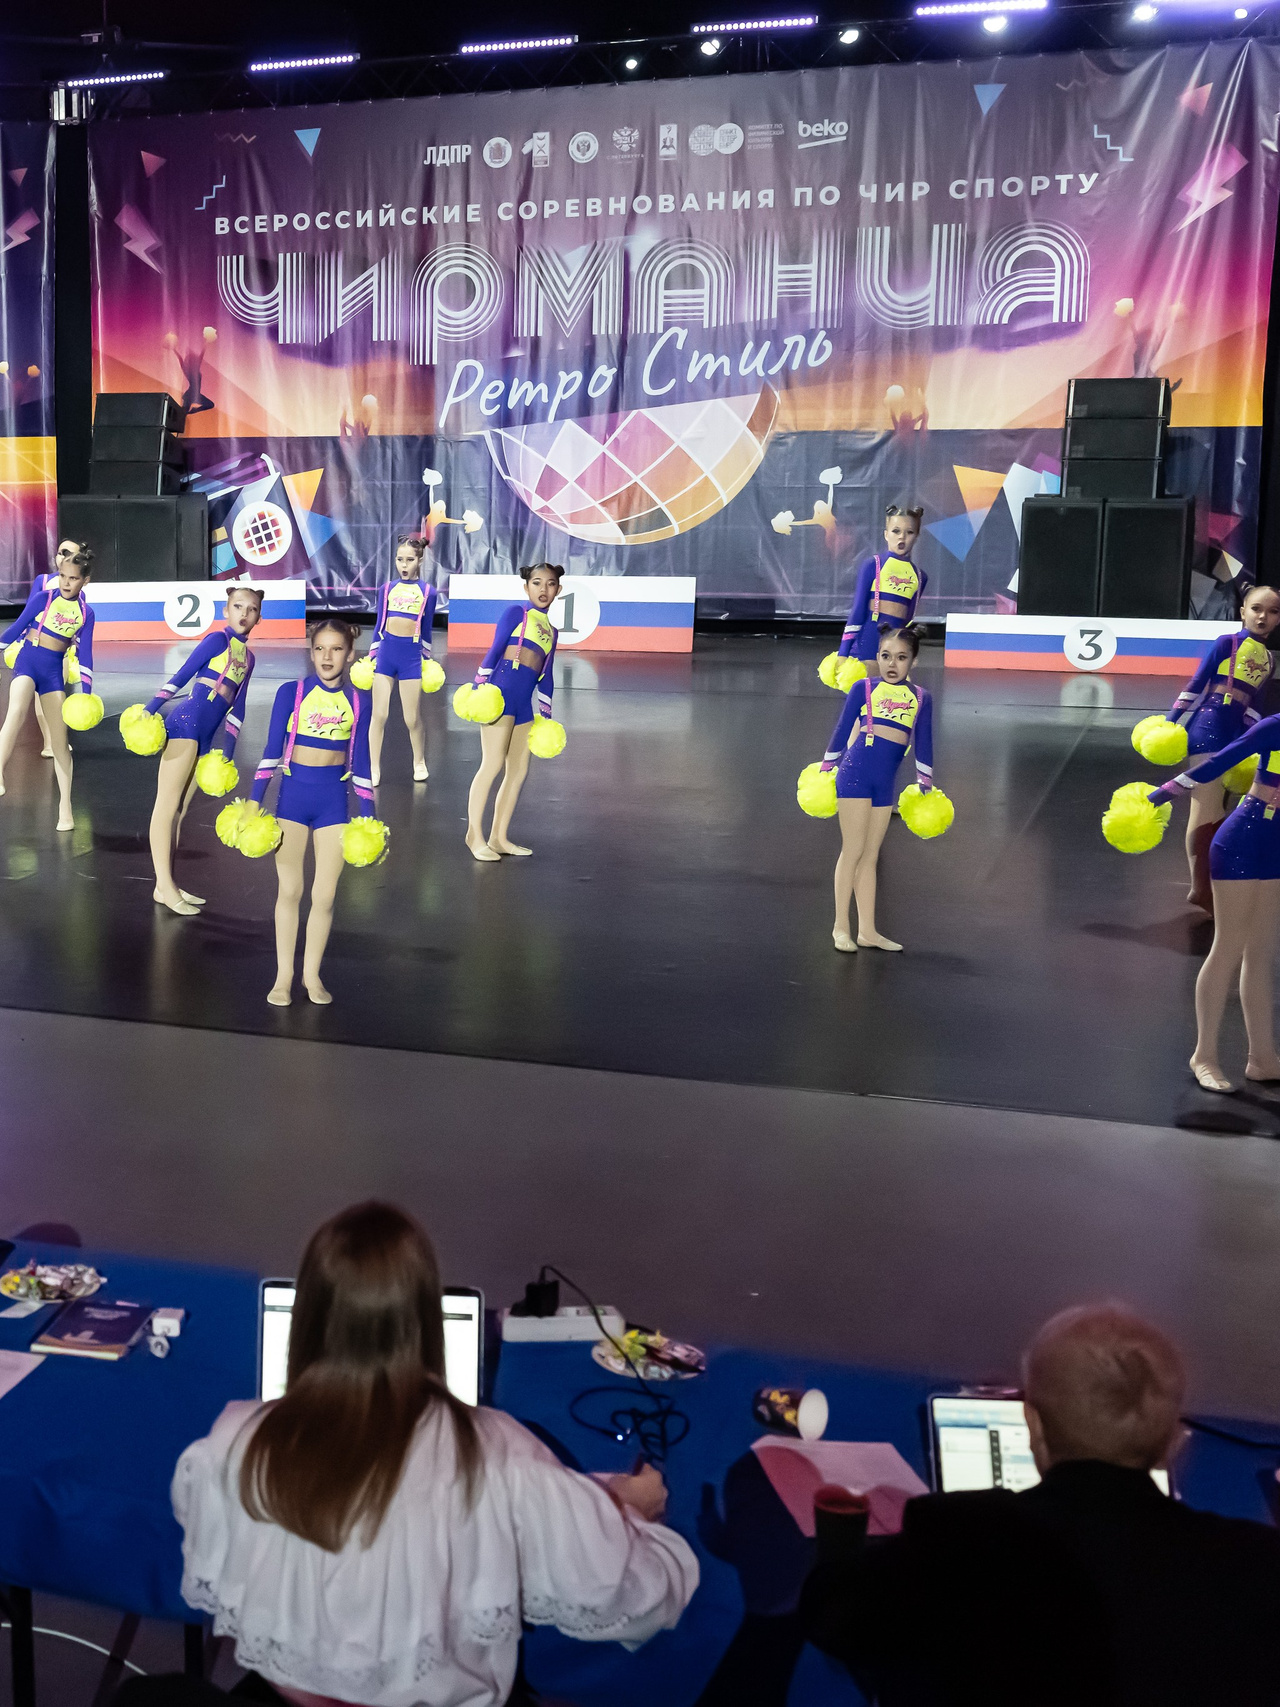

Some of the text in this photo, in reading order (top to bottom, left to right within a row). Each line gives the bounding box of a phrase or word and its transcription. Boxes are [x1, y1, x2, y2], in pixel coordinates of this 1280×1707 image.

[798, 118, 849, 138] beko
[423, 144, 472, 166] ЛДПР
[215, 173, 1100, 235] ВСЕРОССИЙСКИЕ СОРЕВНОВАНИЯ ПО ЧИР СПОРТУ
[438, 326, 832, 428] Ретро Стиль
[177, 594, 201, 628] 2
[558, 592, 579, 632] 1
[1078, 629, 1103, 661] 3
